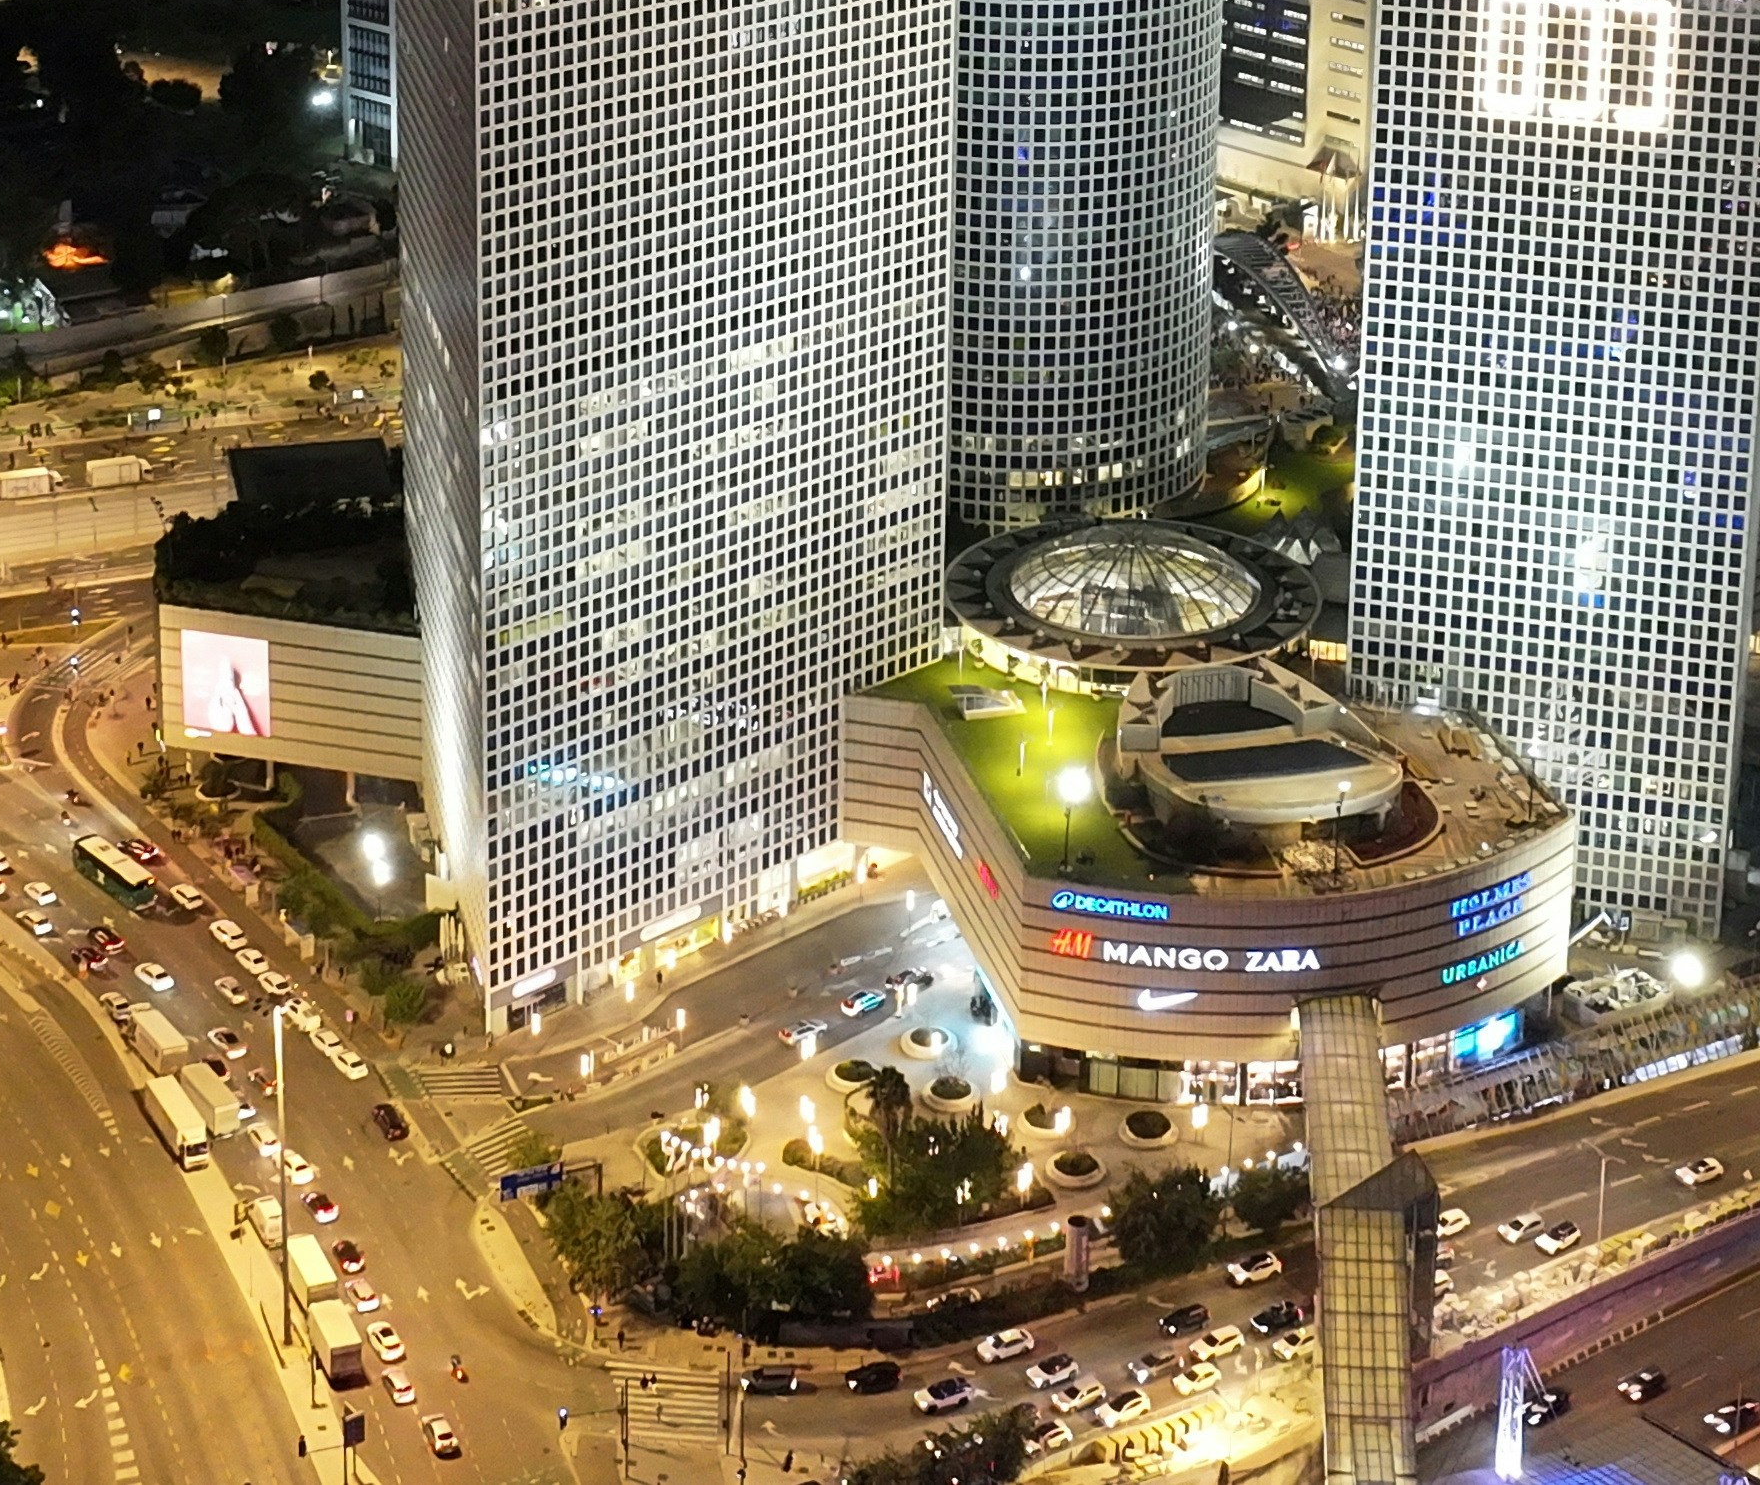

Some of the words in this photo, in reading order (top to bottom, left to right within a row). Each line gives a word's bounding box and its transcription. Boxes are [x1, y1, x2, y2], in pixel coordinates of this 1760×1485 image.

[1074, 893, 1169, 921] DECATHLON
[1458, 896, 1524, 936] PLACE
[1102, 940, 1230, 972] MANGO
[1244, 949, 1321, 973] ZARA
[1442, 940, 1525, 985] URBANICA
